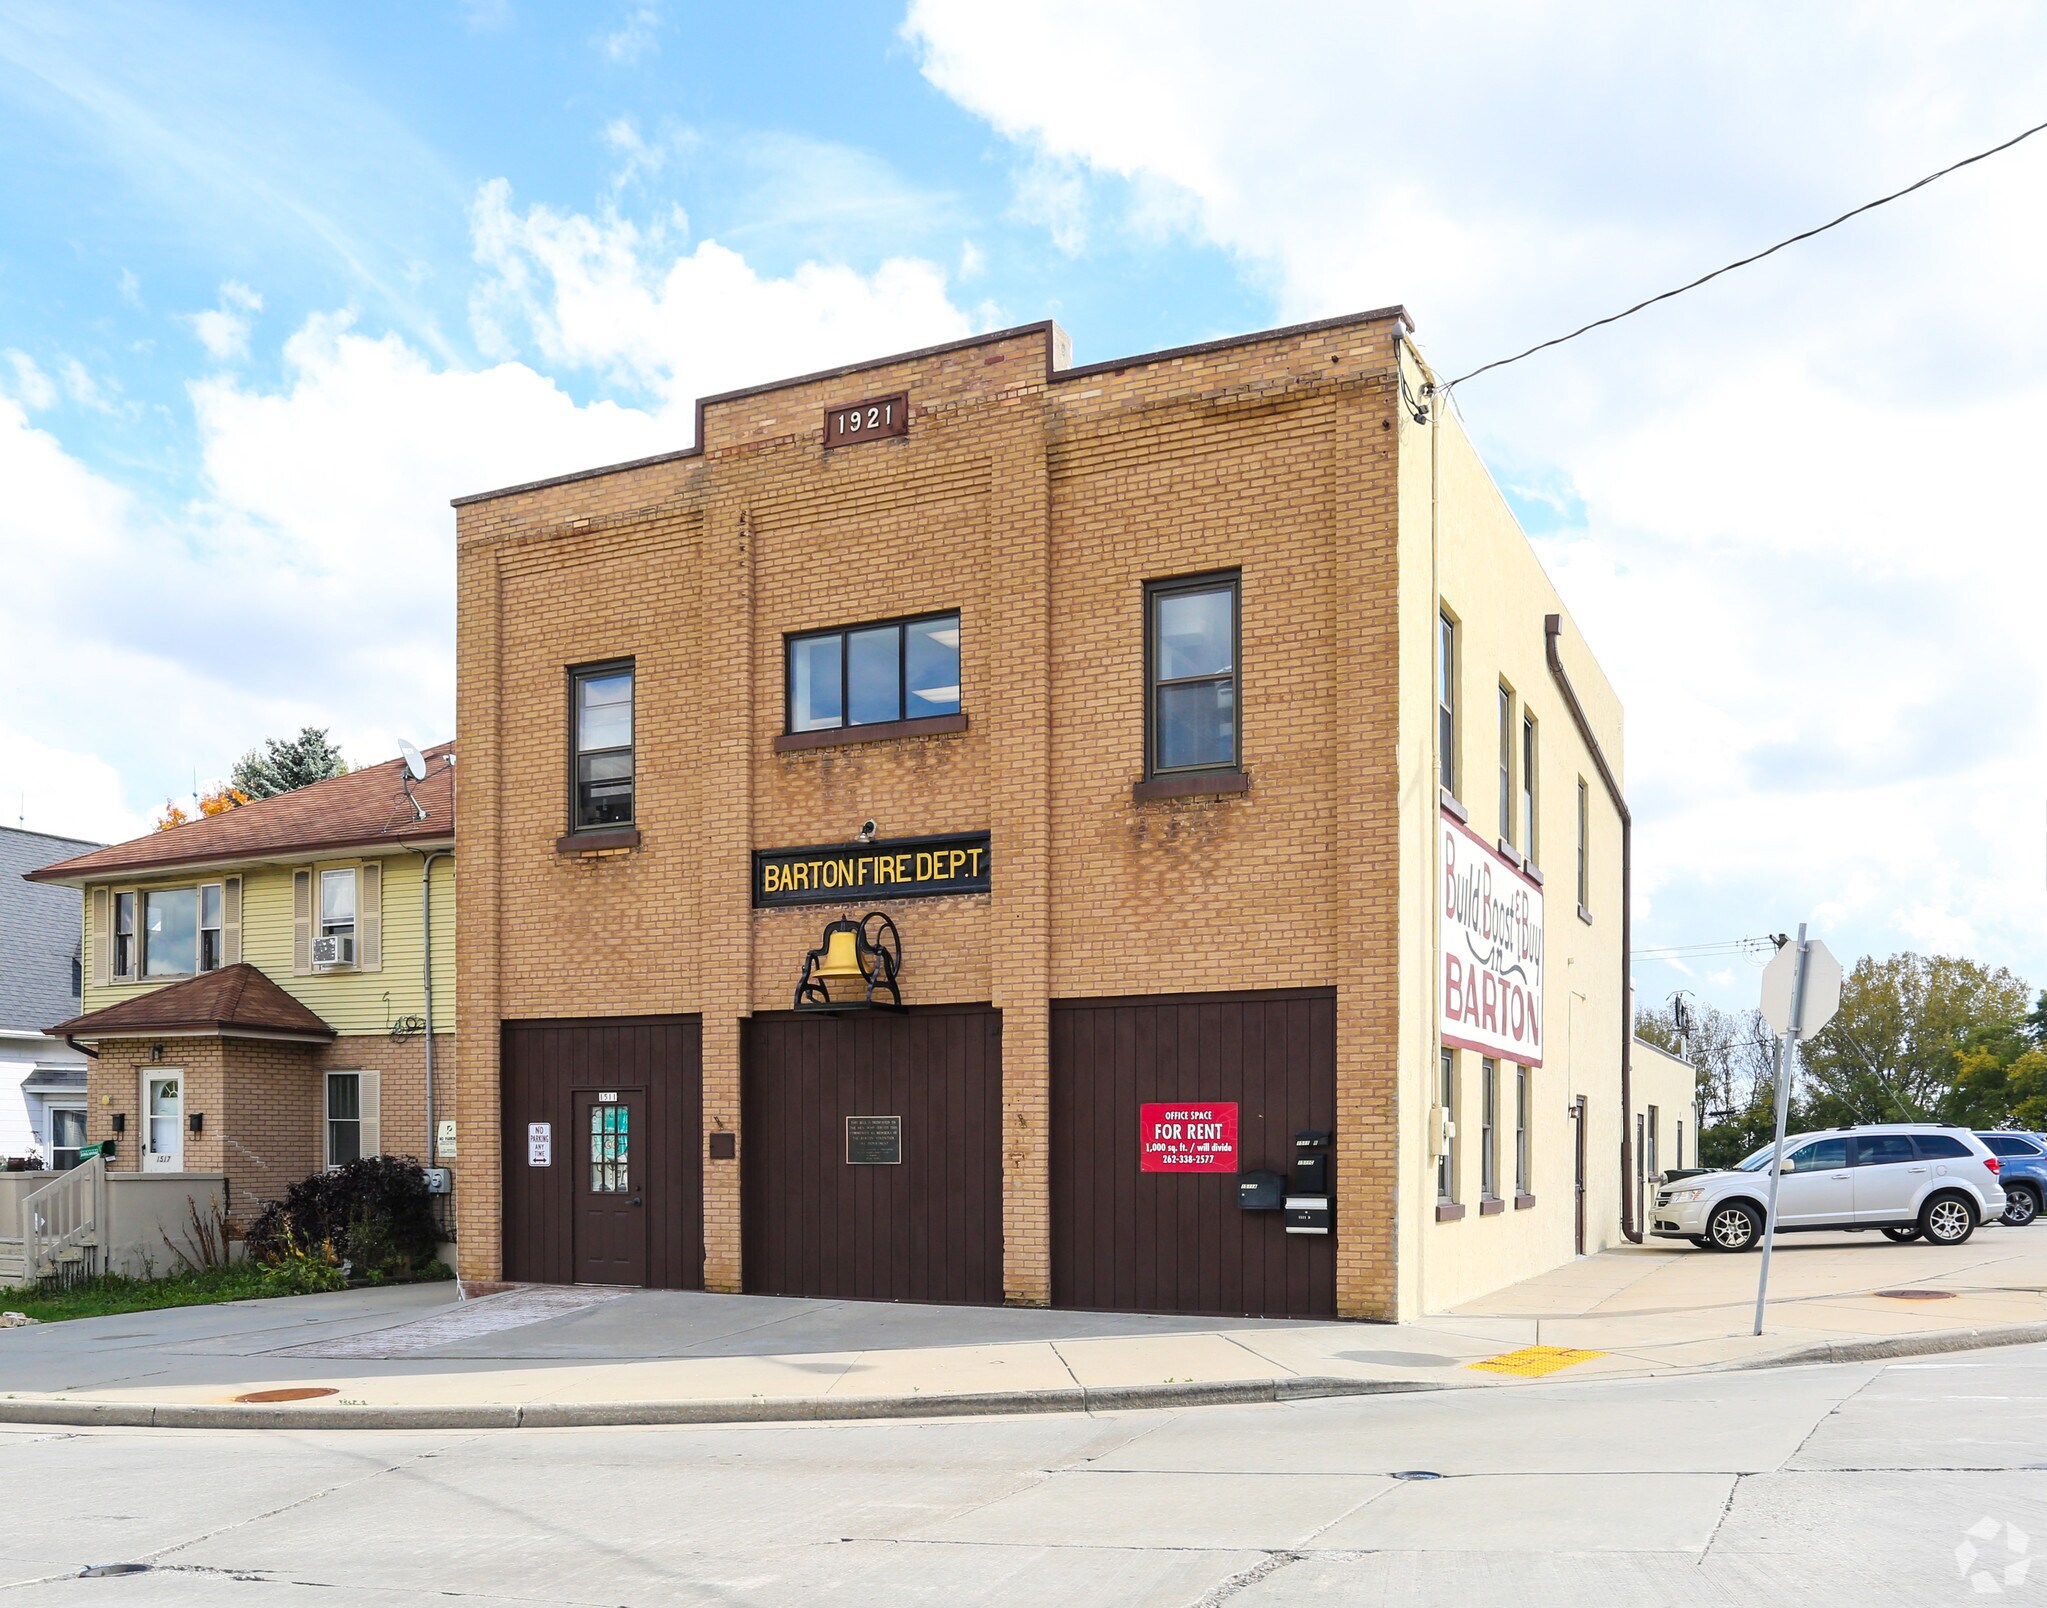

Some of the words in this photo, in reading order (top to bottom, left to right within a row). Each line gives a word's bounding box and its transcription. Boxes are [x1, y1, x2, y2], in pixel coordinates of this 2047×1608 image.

[838, 404, 891, 434] 1921
[764, 859, 853, 892] BARTON
[857, 854, 912, 886] FIRE
[1483, 861, 1514, 953] Boost
[1522, 890, 1541, 987] Buy
[1445, 952, 1539, 1046] BARTON
[600, 1093, 616, 1101] 1511
[1165, 1111, 1188, 1120] OFFICE
[1191, 1111, 1212, 1120] SPACE
[535, 1126, 544, 1134] NO
[1155, 1123, 1182, 1140] FOR
[1187, 1123, 1223, 1140] RENT
[530, 1135, 549, 1143] PARKING
[1146, 1143, 1166, 1153] 1,000
[1167, 1145, 1178, 1154] sq.
[1196, 1142, 1210, 1152] will
[1211, 1142, 1233, 1152] divide
[156, 1155, 171, 1163] 1517
[1162, 1155, 1214, 1164] 262-338-2577
